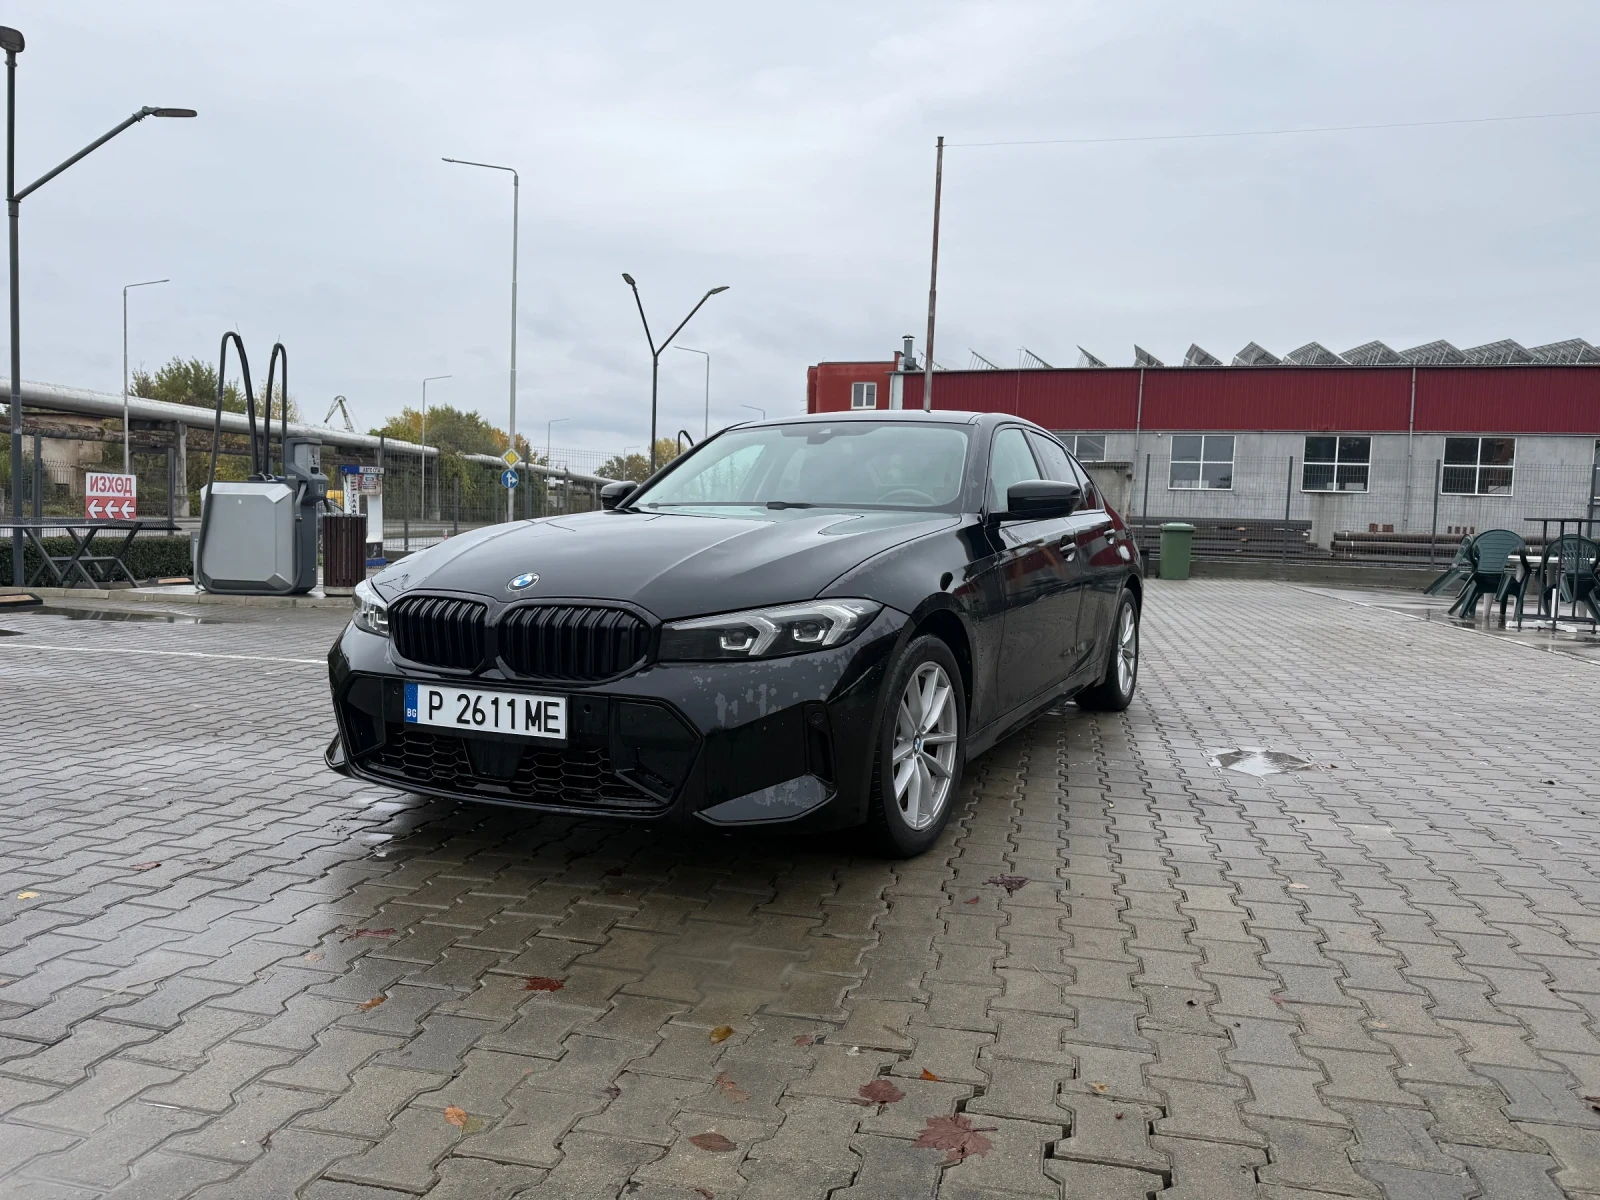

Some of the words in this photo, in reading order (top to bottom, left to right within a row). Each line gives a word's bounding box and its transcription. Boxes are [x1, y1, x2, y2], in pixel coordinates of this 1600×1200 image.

[90, 475, 132, 496] ИЗХОД
[406, 708, 417, 718] BG
[428, 690, 443, 720] P
[456, 693, 516, 730] 2611
[525, 699, 560, 734] ME
